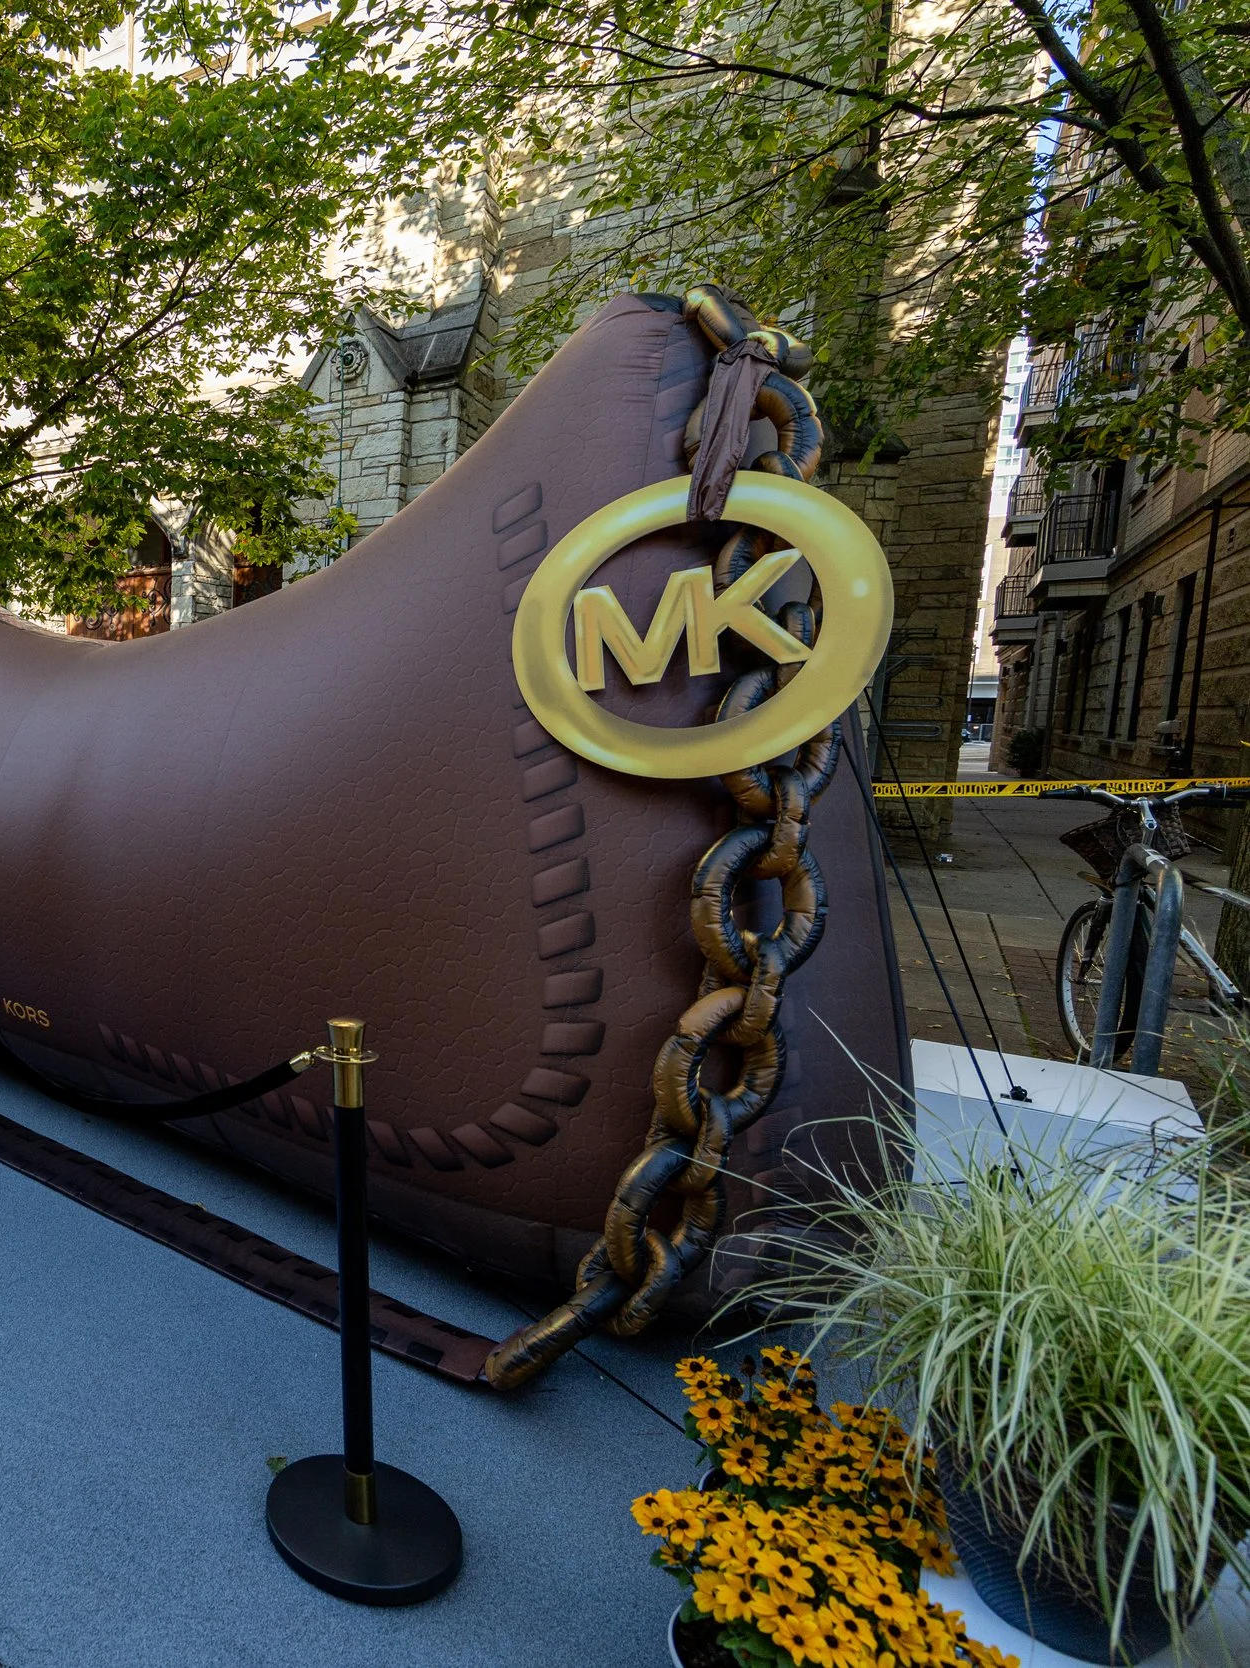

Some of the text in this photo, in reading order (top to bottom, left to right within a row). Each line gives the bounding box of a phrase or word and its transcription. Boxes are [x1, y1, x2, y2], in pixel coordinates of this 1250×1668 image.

[573, 547, 813, 692] MK
[946, 784, 999, 795] CAUTION
[1105, 781, 1166, 794] CAUTION
[2, 997, 51, 1029] KORS
